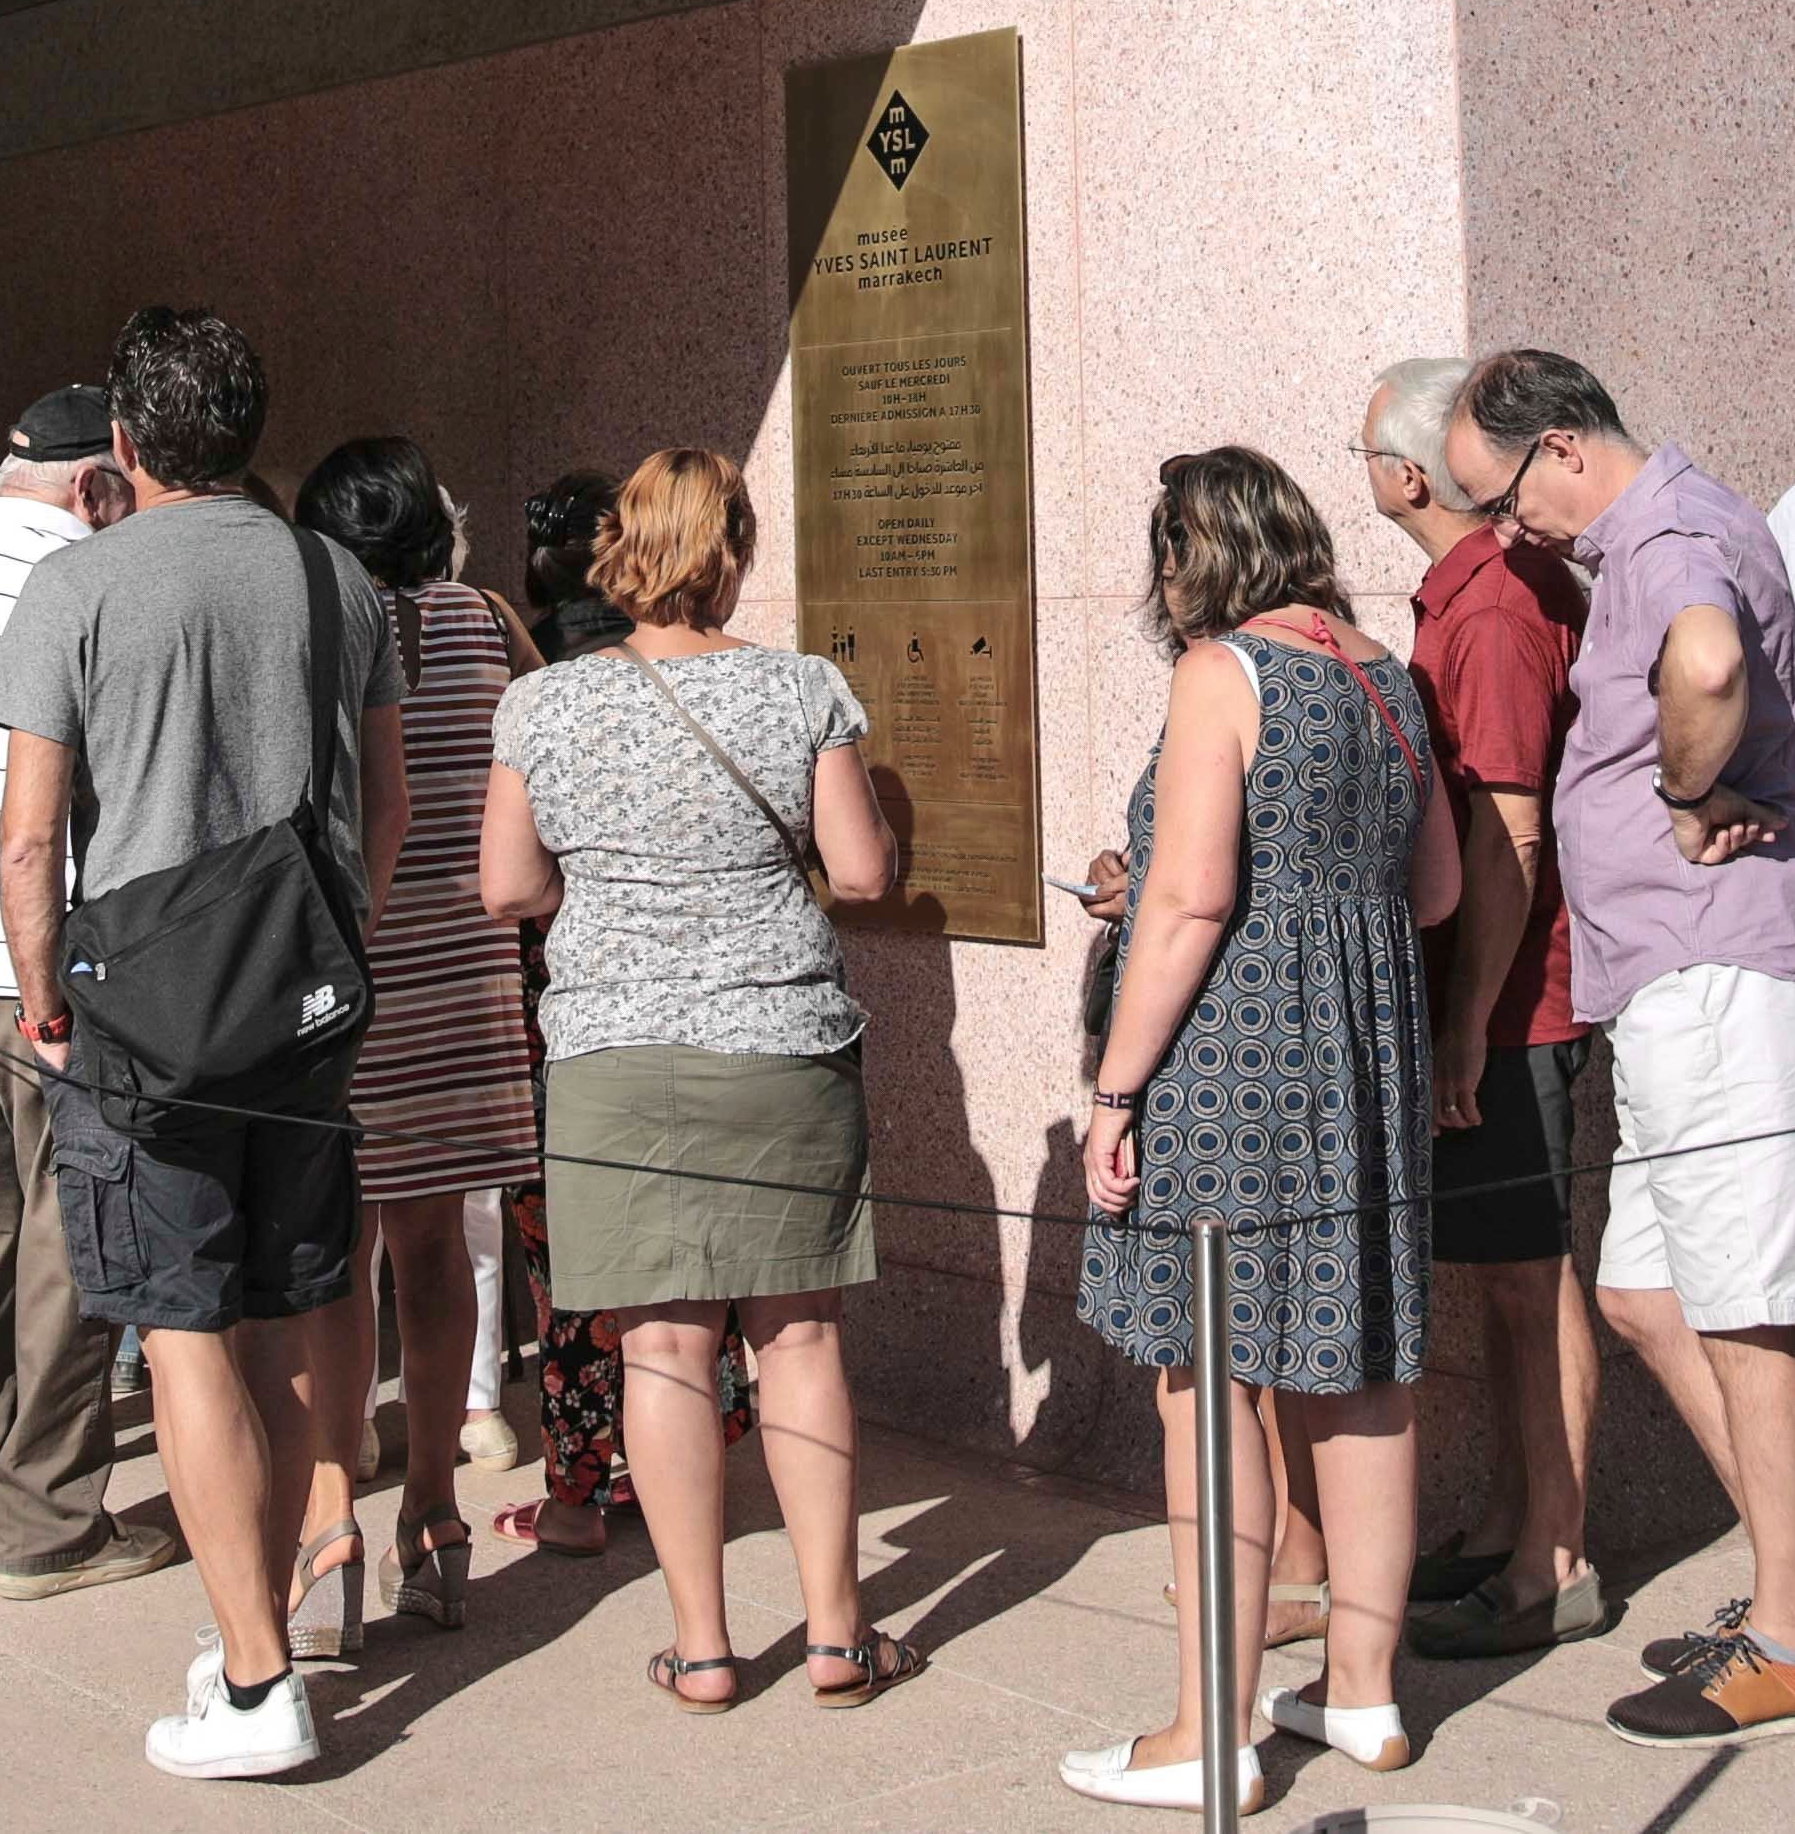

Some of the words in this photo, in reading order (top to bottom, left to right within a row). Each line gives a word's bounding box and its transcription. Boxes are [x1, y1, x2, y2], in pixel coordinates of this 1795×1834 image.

[889, 106, 905, 124] m
[879, 127, 916, 154] YSL
[890, 156, 906, 175] m
[857, 225, 908, 246] musée
[814, 255, 854, 275] YVES
[860, 248, 908, 270] SAINT
[914, 237, 993, 264] LAURENT
[858, 265, 942, 290] marrakech
[842, 364, 880, 376] OUVERT
[884, 361, 910, 373] TOUS
[912, 358, 931, 371] LES
[934, 355, 966, 369] JOURS
[858, 379, 883, 391] SAUF
[885, 377, 896, 389] LE
[899, 374, 950, 388] MERCREDI
[881, 406, 936, 421] ADMISSION
[878, 518, 905, 529] OPEN
[906, 517, 935, 528] DAILY
[857, 534, 894, 546] EXCEPT
[896, 533, 958, 545] WEDNESDAY
[859, 567, 885, 578] LAST
[886, 566, 918, 578] ENTRY
[943, 565, 958, 576] PM
[315, 1004, 350, 1027] balance
